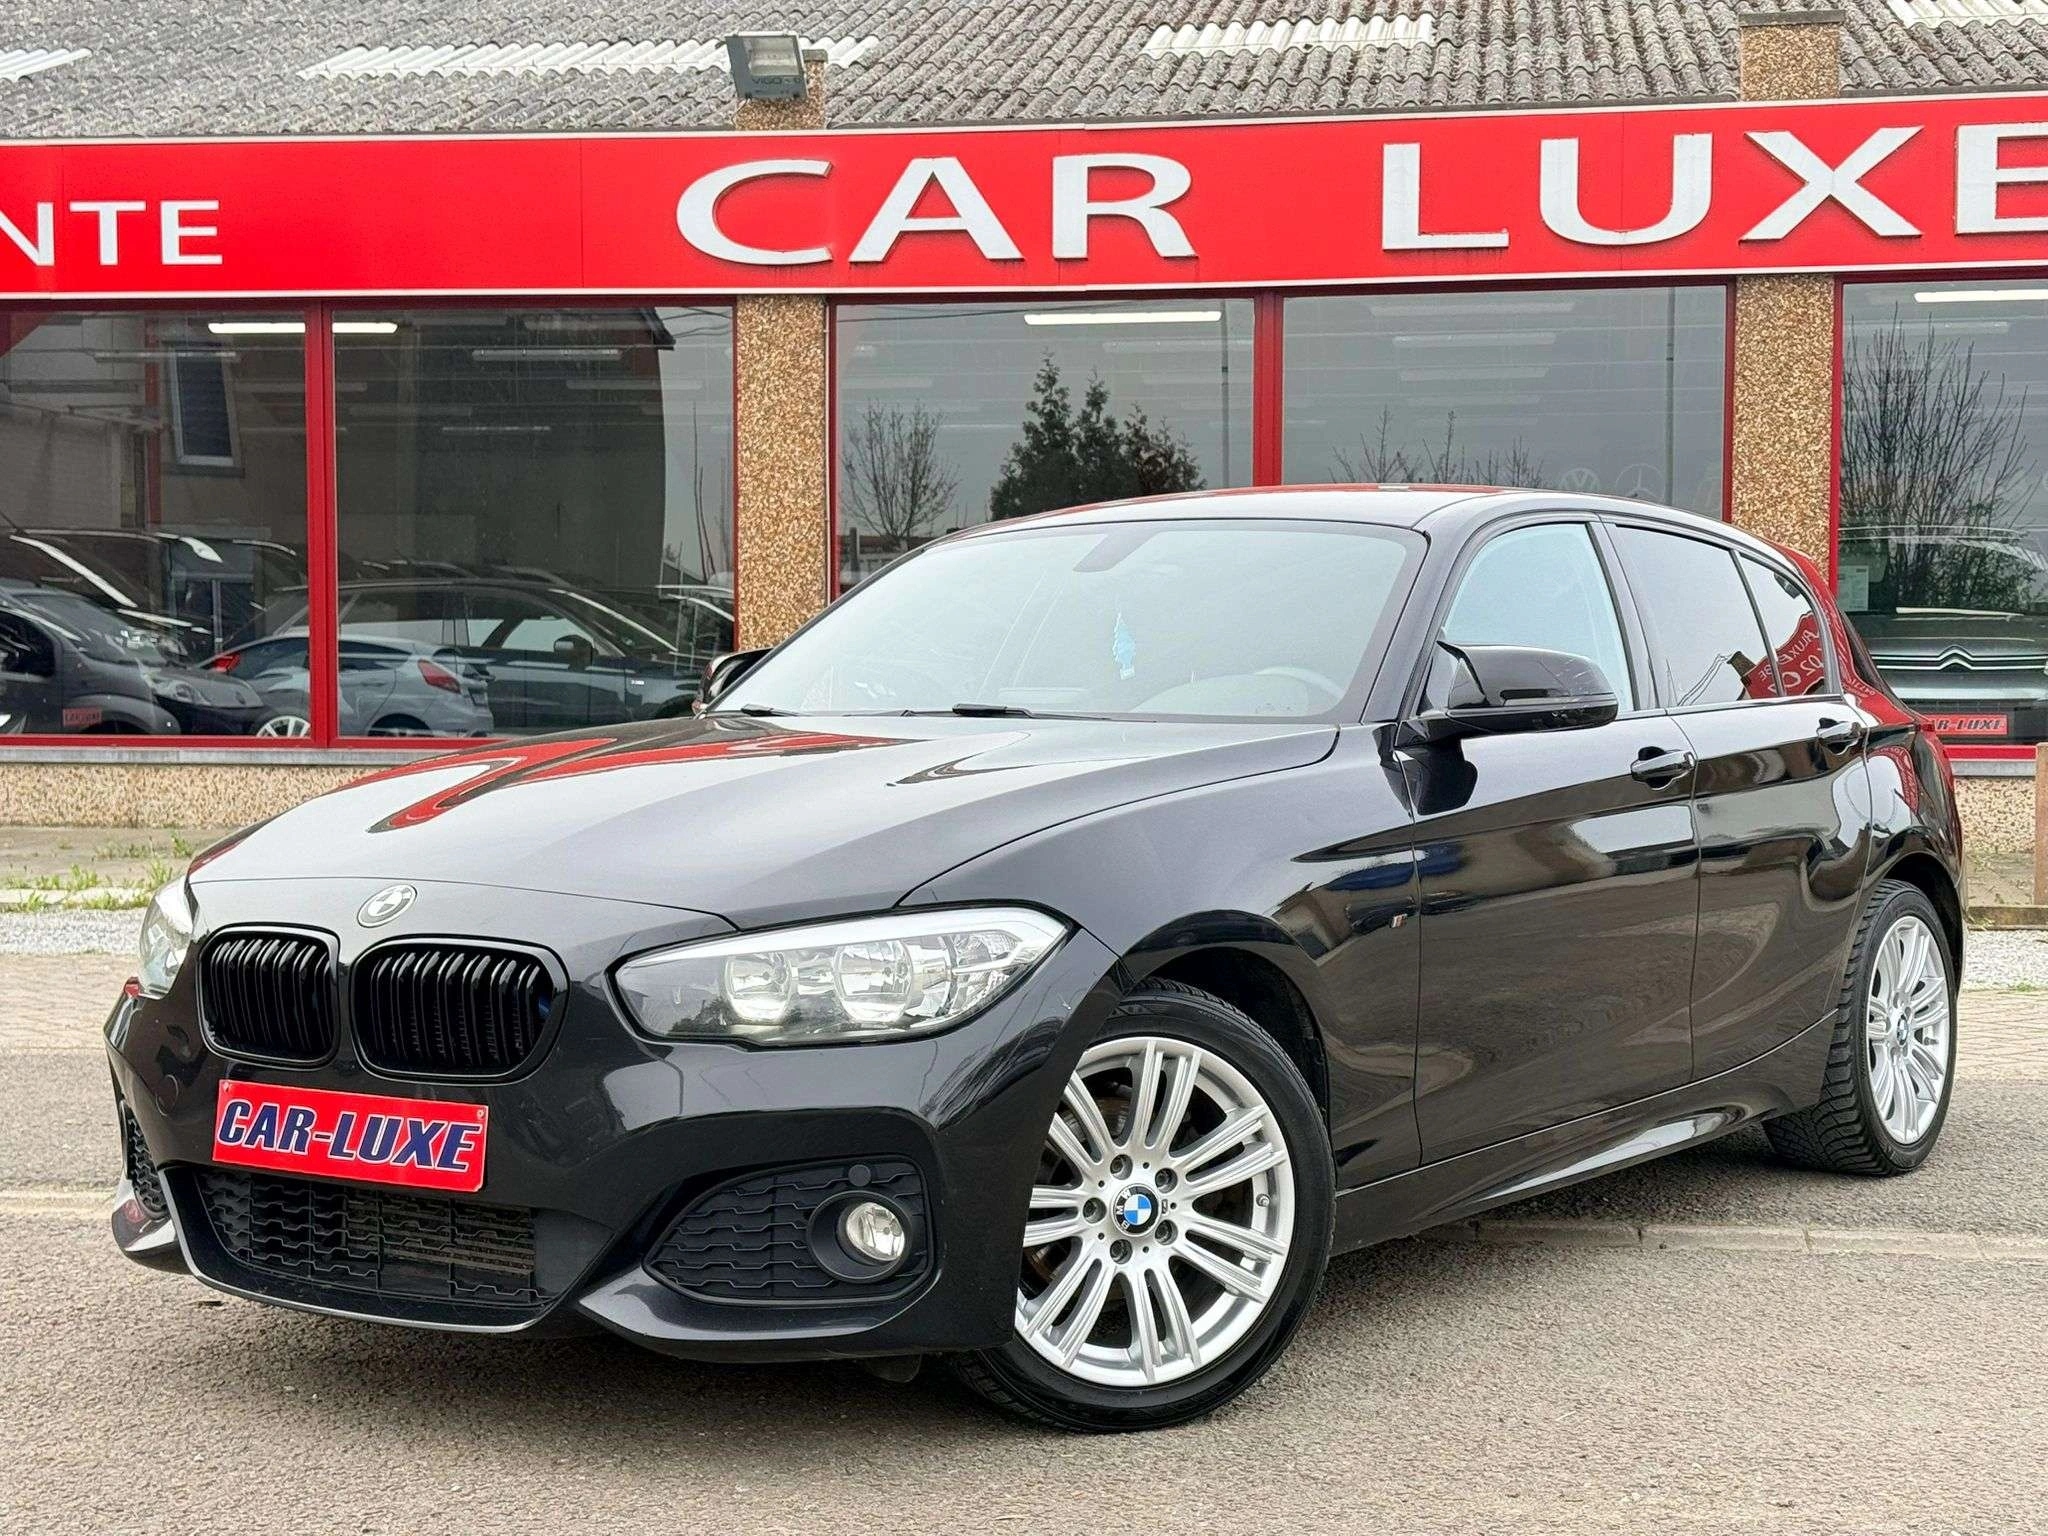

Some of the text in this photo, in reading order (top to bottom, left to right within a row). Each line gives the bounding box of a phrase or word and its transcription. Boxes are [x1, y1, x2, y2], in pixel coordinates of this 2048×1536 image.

[677, 122, 2048, 265] CAR LUXE
[217, 1099, 482, 1173] CAR-LUXE
